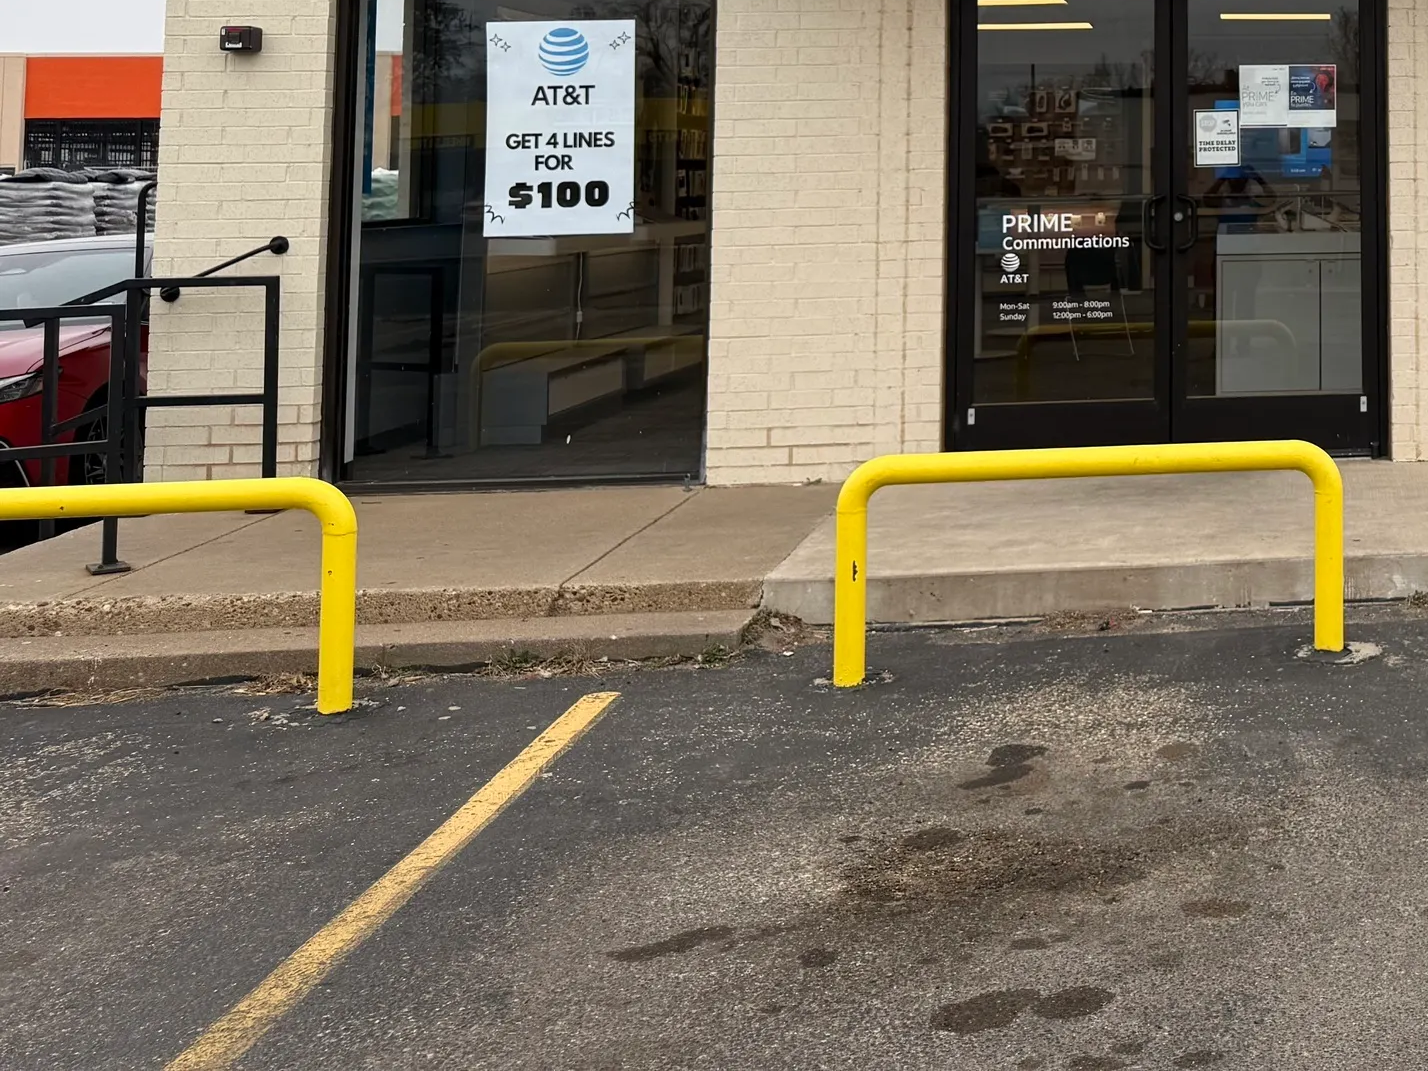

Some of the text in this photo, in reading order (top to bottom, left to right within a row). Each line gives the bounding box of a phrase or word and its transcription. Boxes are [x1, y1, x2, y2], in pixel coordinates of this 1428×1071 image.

[531, 85, 596, 107] AT&T
[1290, 95, 1315, 103] PRIME
[505, 131, 615, 150] GET 4 LINES
[534, 154, 574, 171] FOR
[508, 180, 610, 209] $100
[1002, 213, 1074, 233] PRIME
[1002, 234, 1130, 250] Communications
[1000, 274, 1030, 284] AT&T
[1000, 302, 1030, 310] Mon-Sat
[1000, 313, 1026, 322] Sunday
